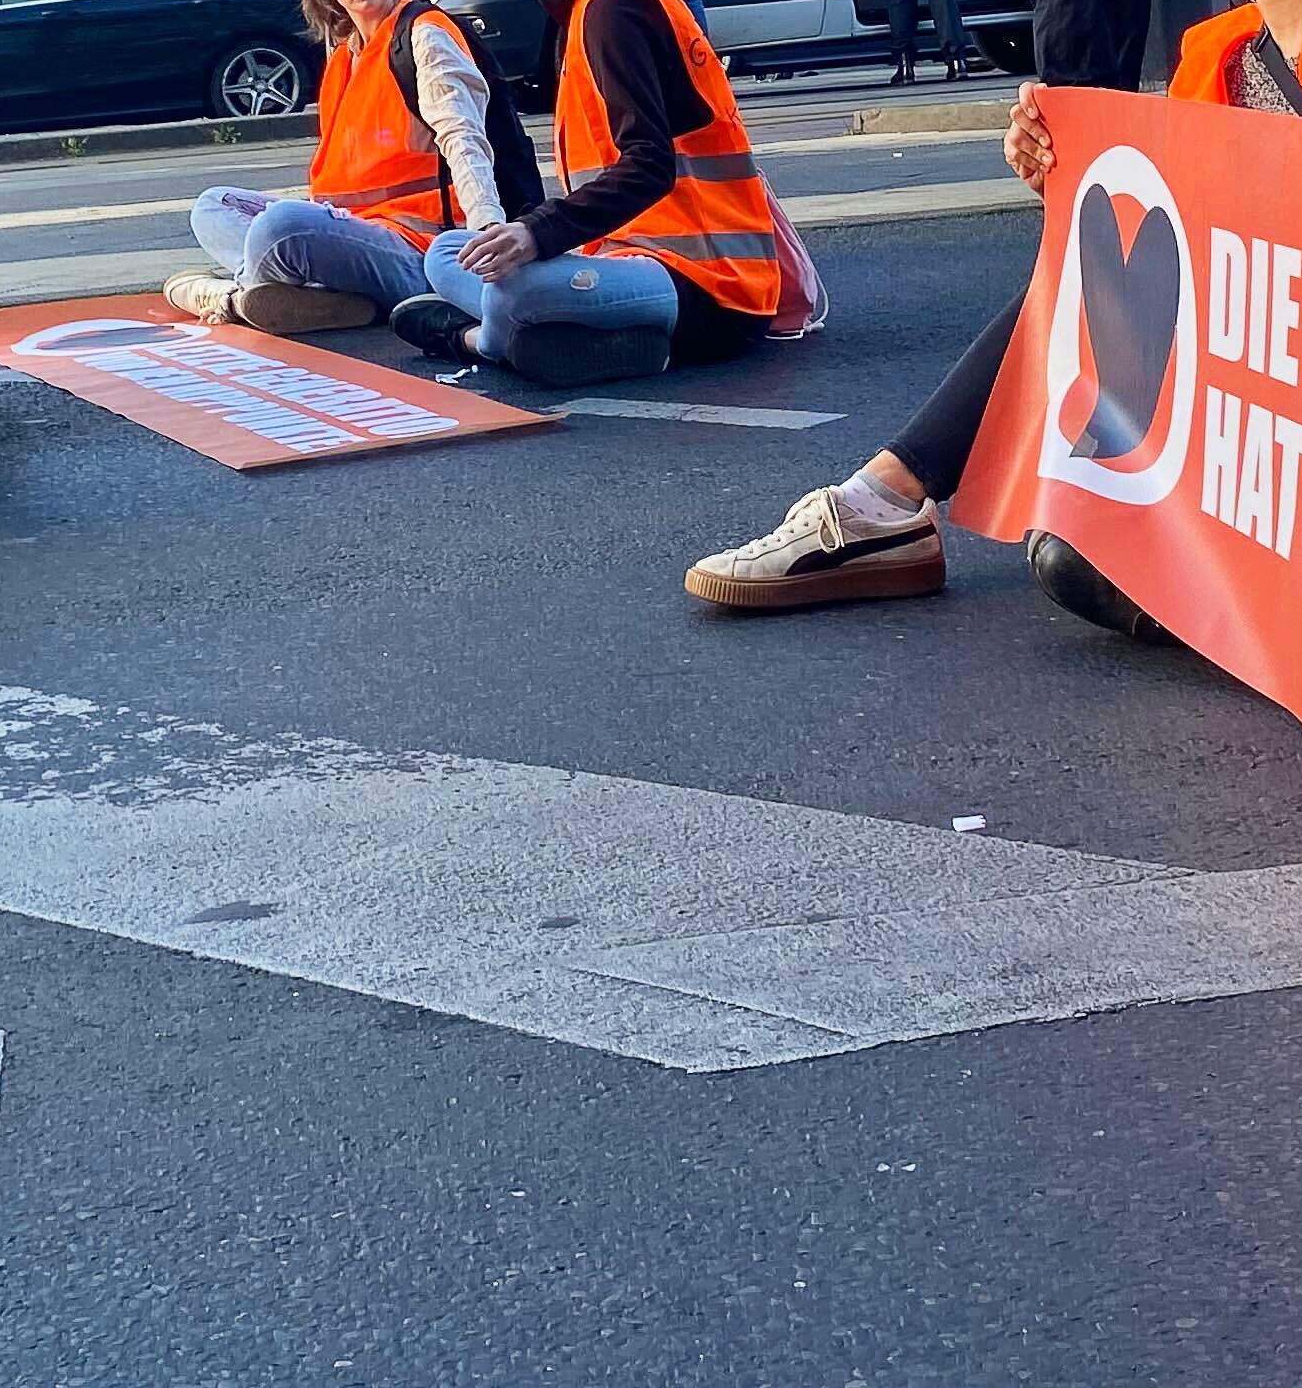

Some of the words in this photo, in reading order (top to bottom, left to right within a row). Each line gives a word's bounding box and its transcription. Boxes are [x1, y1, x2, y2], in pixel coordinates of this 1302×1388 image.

[1207, 224, 1302, 387] DIE
[154, 381, 370, 454] KIPPPUNKTE
[228, 368, 460, 439] GENERATIO
